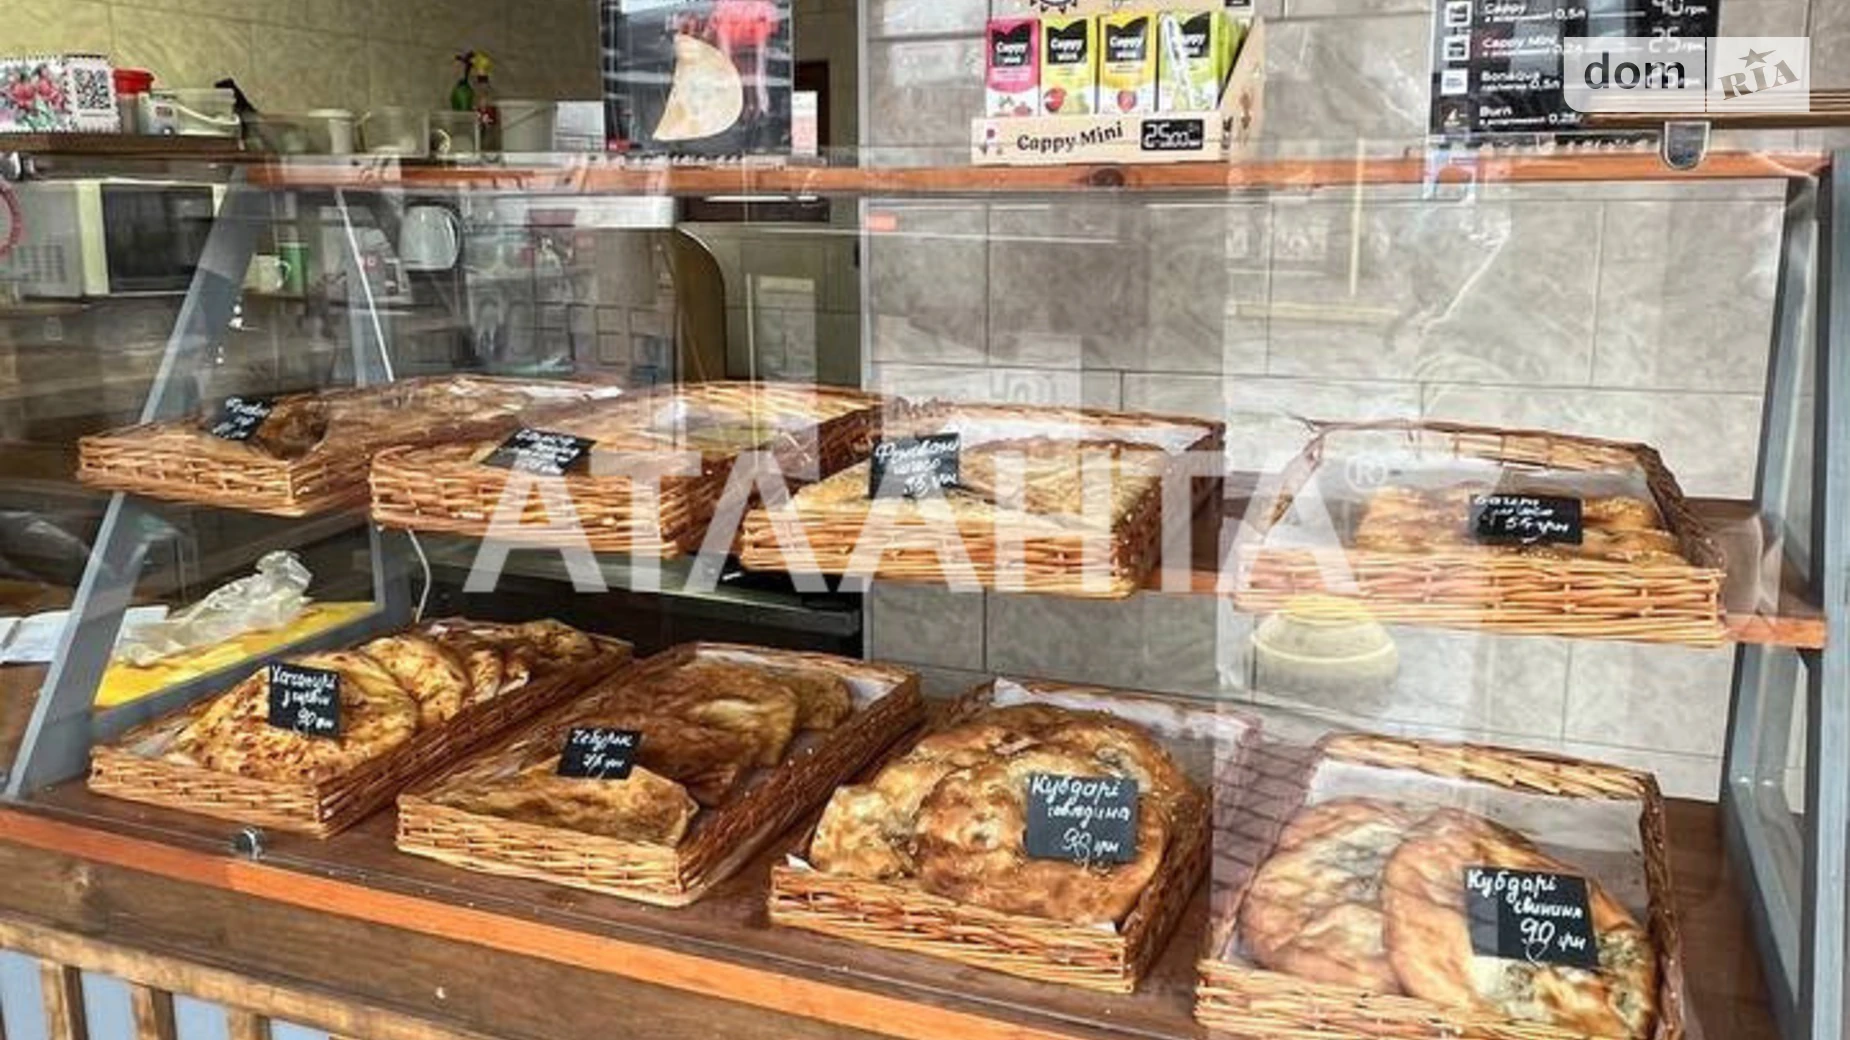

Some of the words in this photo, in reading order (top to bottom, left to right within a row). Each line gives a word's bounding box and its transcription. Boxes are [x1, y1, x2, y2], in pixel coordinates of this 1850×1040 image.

[1017, 133, 1075, 153] Cappy
[1080, 120, 1123, 145] Mini
[1466, 868, 1557, 904] Кубдарі
[1520, 917, 1556, 945] 90
